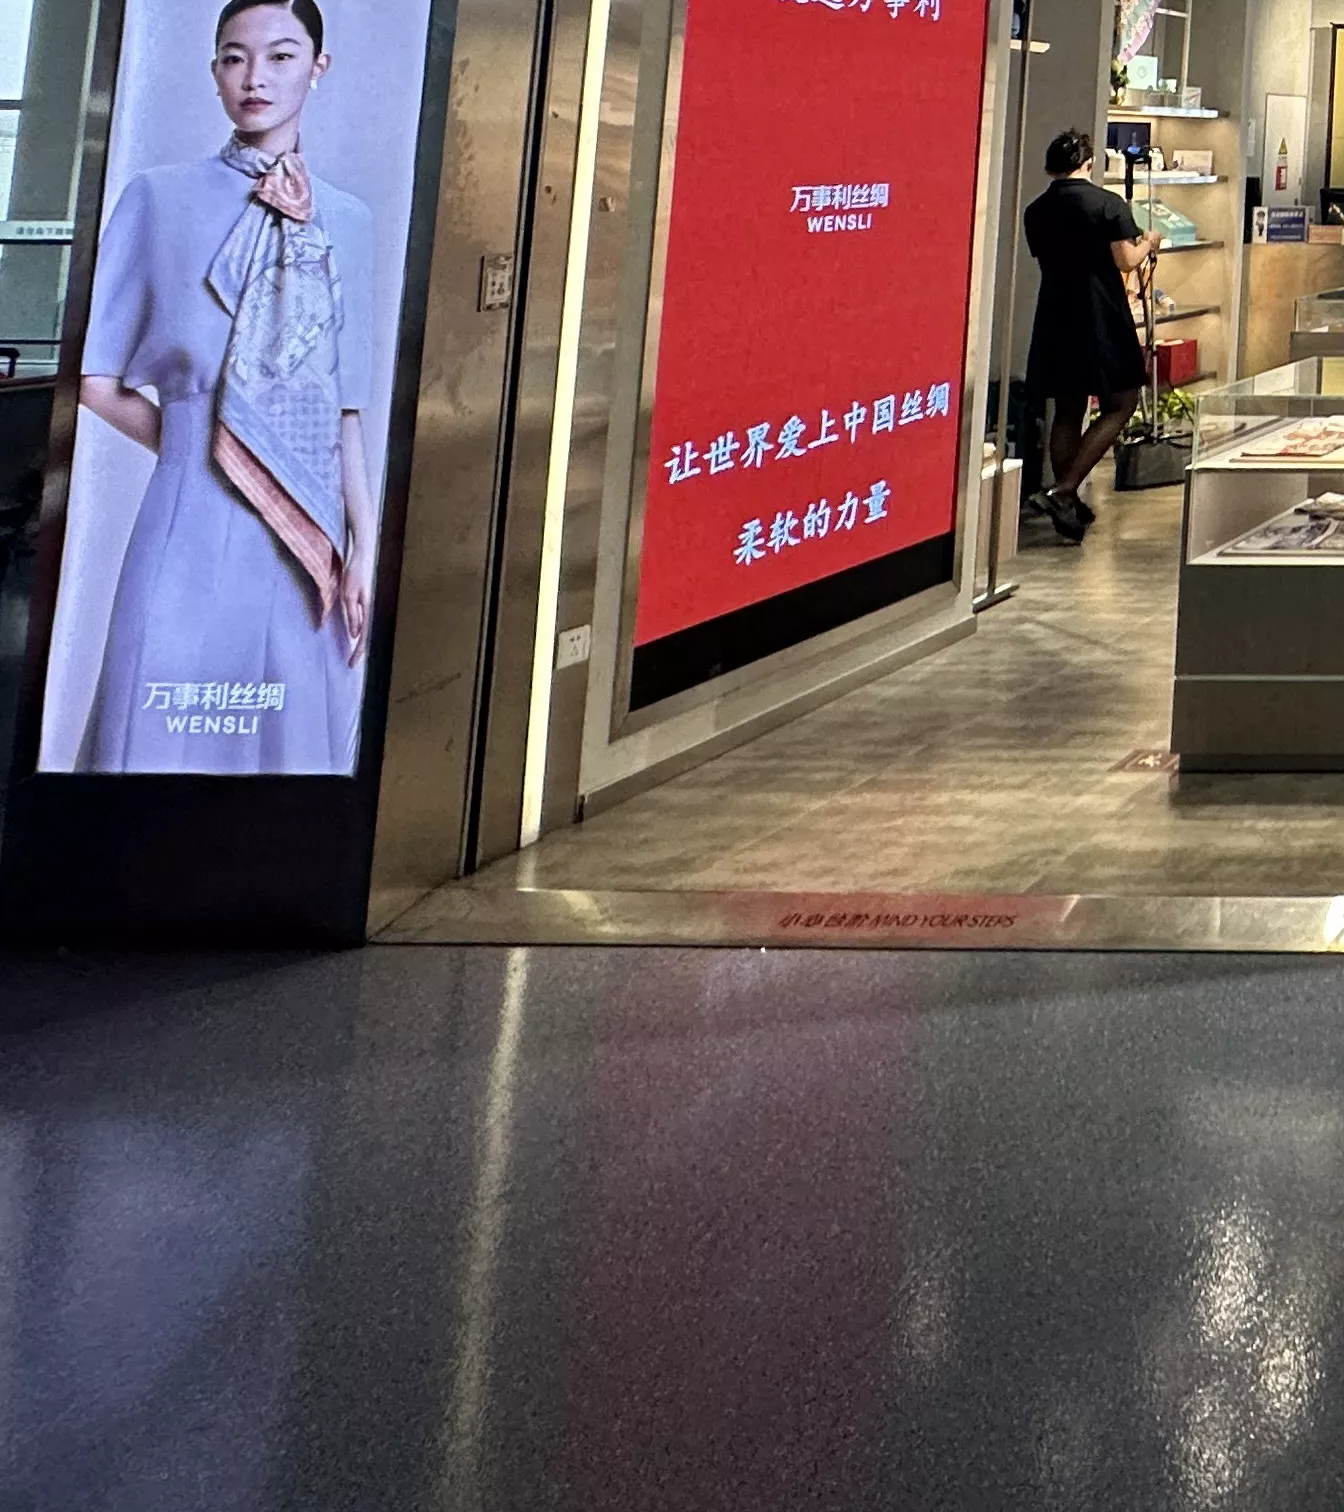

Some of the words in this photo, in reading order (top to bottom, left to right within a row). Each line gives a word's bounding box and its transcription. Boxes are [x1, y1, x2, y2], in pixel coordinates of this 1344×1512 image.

[789, 182, 890, 212] 万事利丝绸
[806, 213, 872, 234] WENSLI
[663, 381, 951, 486] 让世界爱上中国丝绸
[733, 479, 892, 567] 柔软的力量
[142, 682, 287, 711] 万事利丝绸
[166, 715, 260, 734] WENSLI
[869, 913, 918, 928] MIND
[920, 913, 970, 928] YOUR
